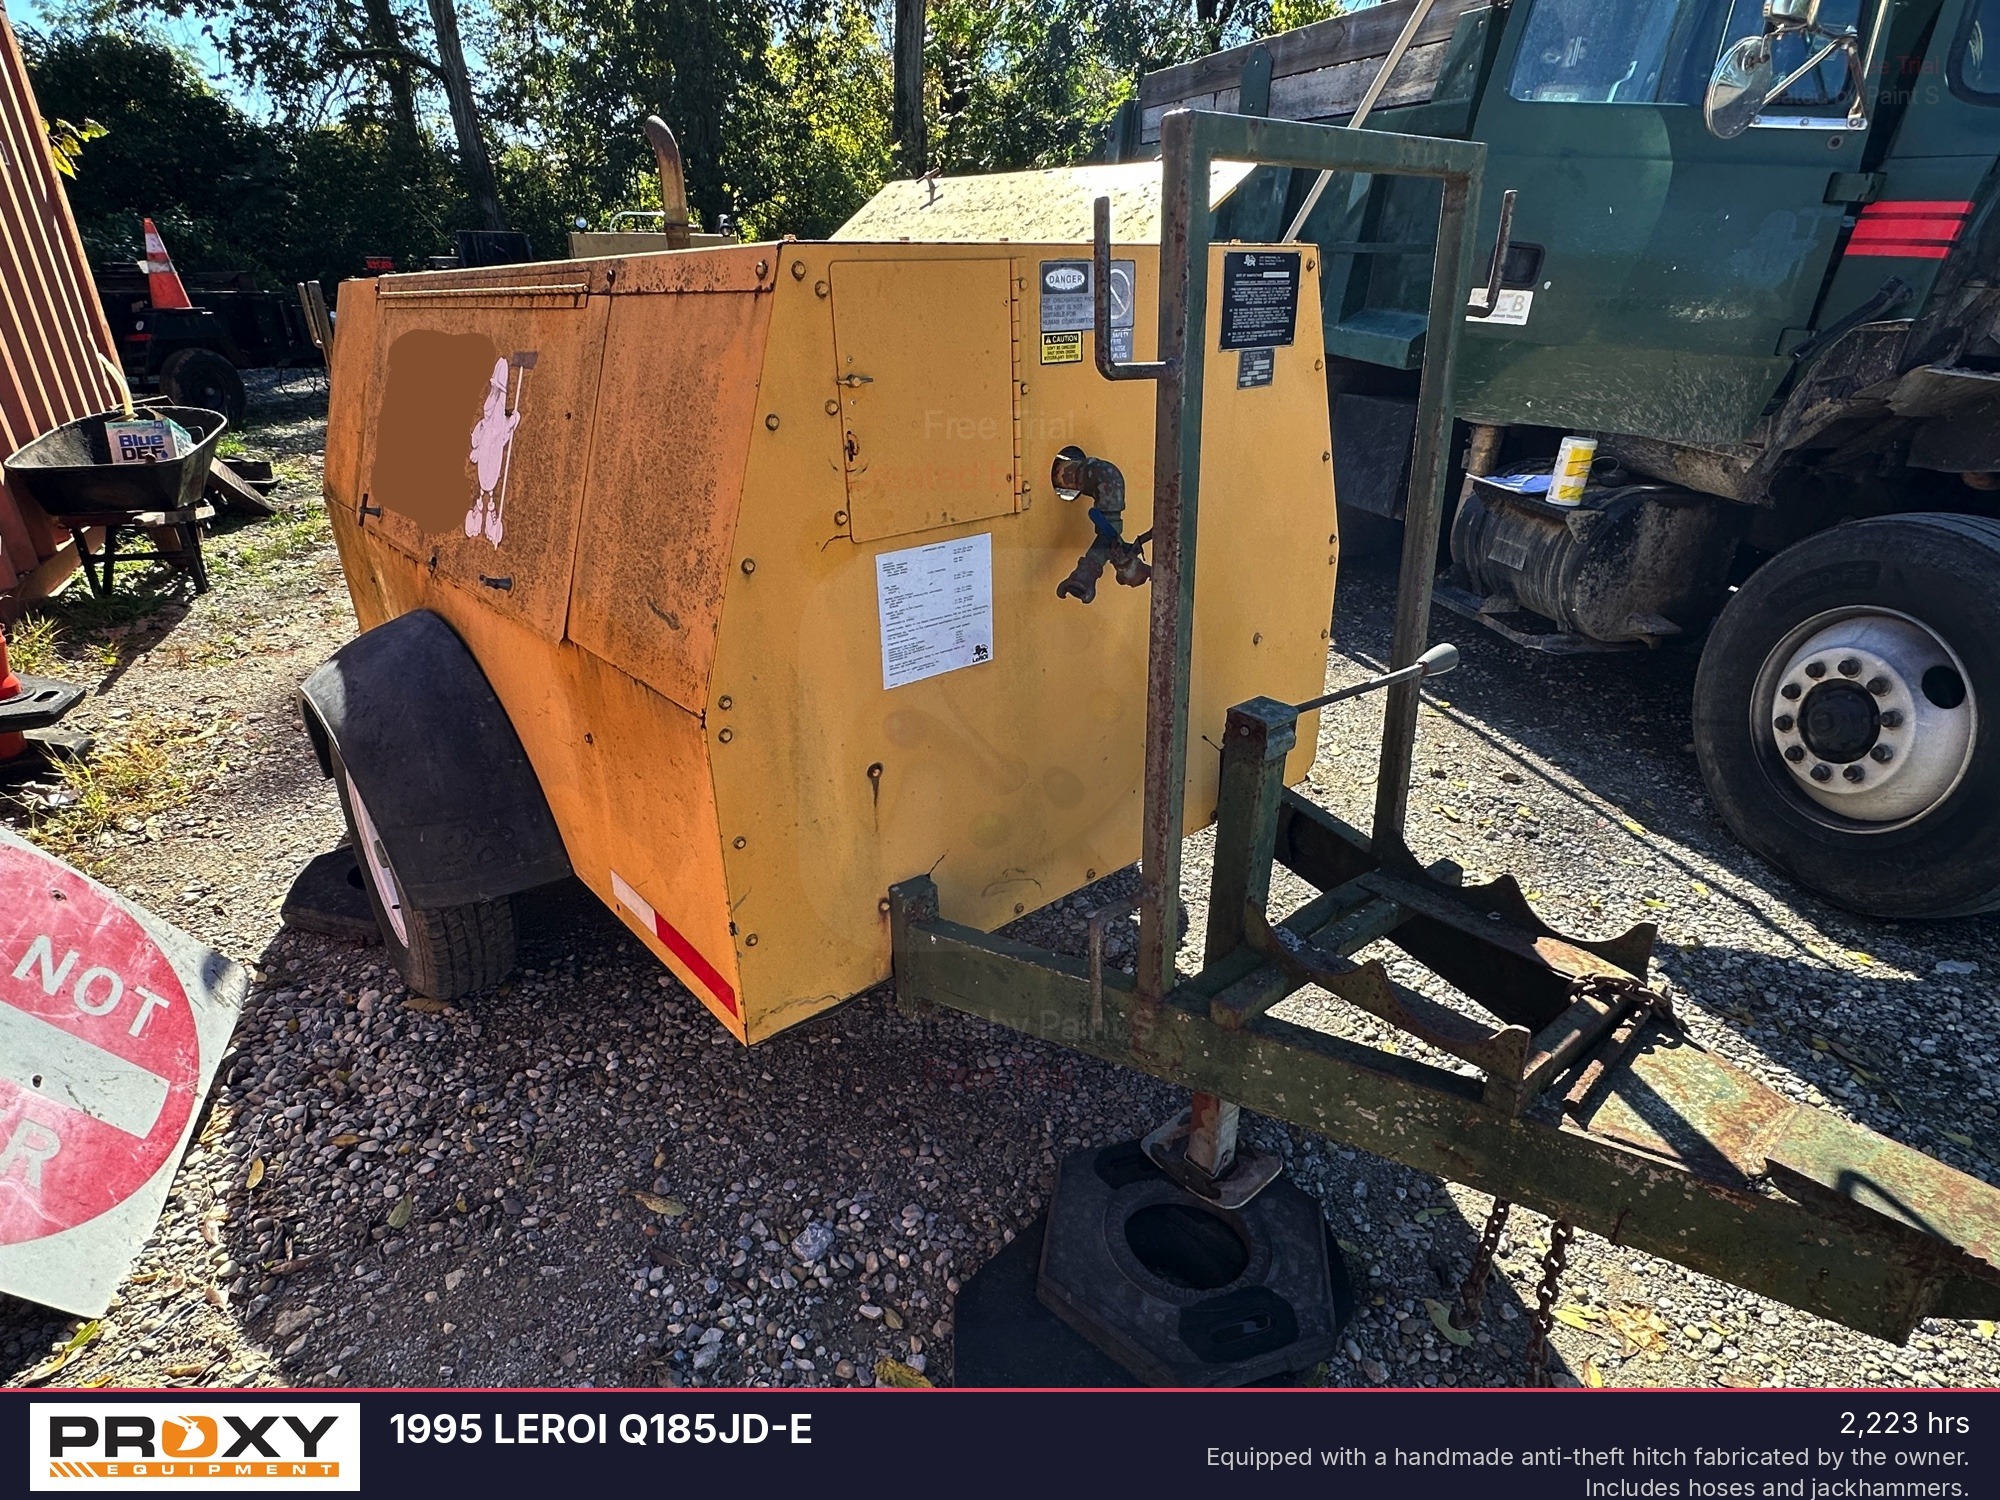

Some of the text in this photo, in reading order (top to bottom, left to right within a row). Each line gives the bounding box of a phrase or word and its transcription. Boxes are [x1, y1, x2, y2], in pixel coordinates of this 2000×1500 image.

[1049, 275, 1083, 284] DANGER
[1052, 334, 1078, 343] CAUTION
[119, 434, 164, 447] Blue
[121, 445, 165, 461] DEF
[12, 935, 171, 1038] NOT
